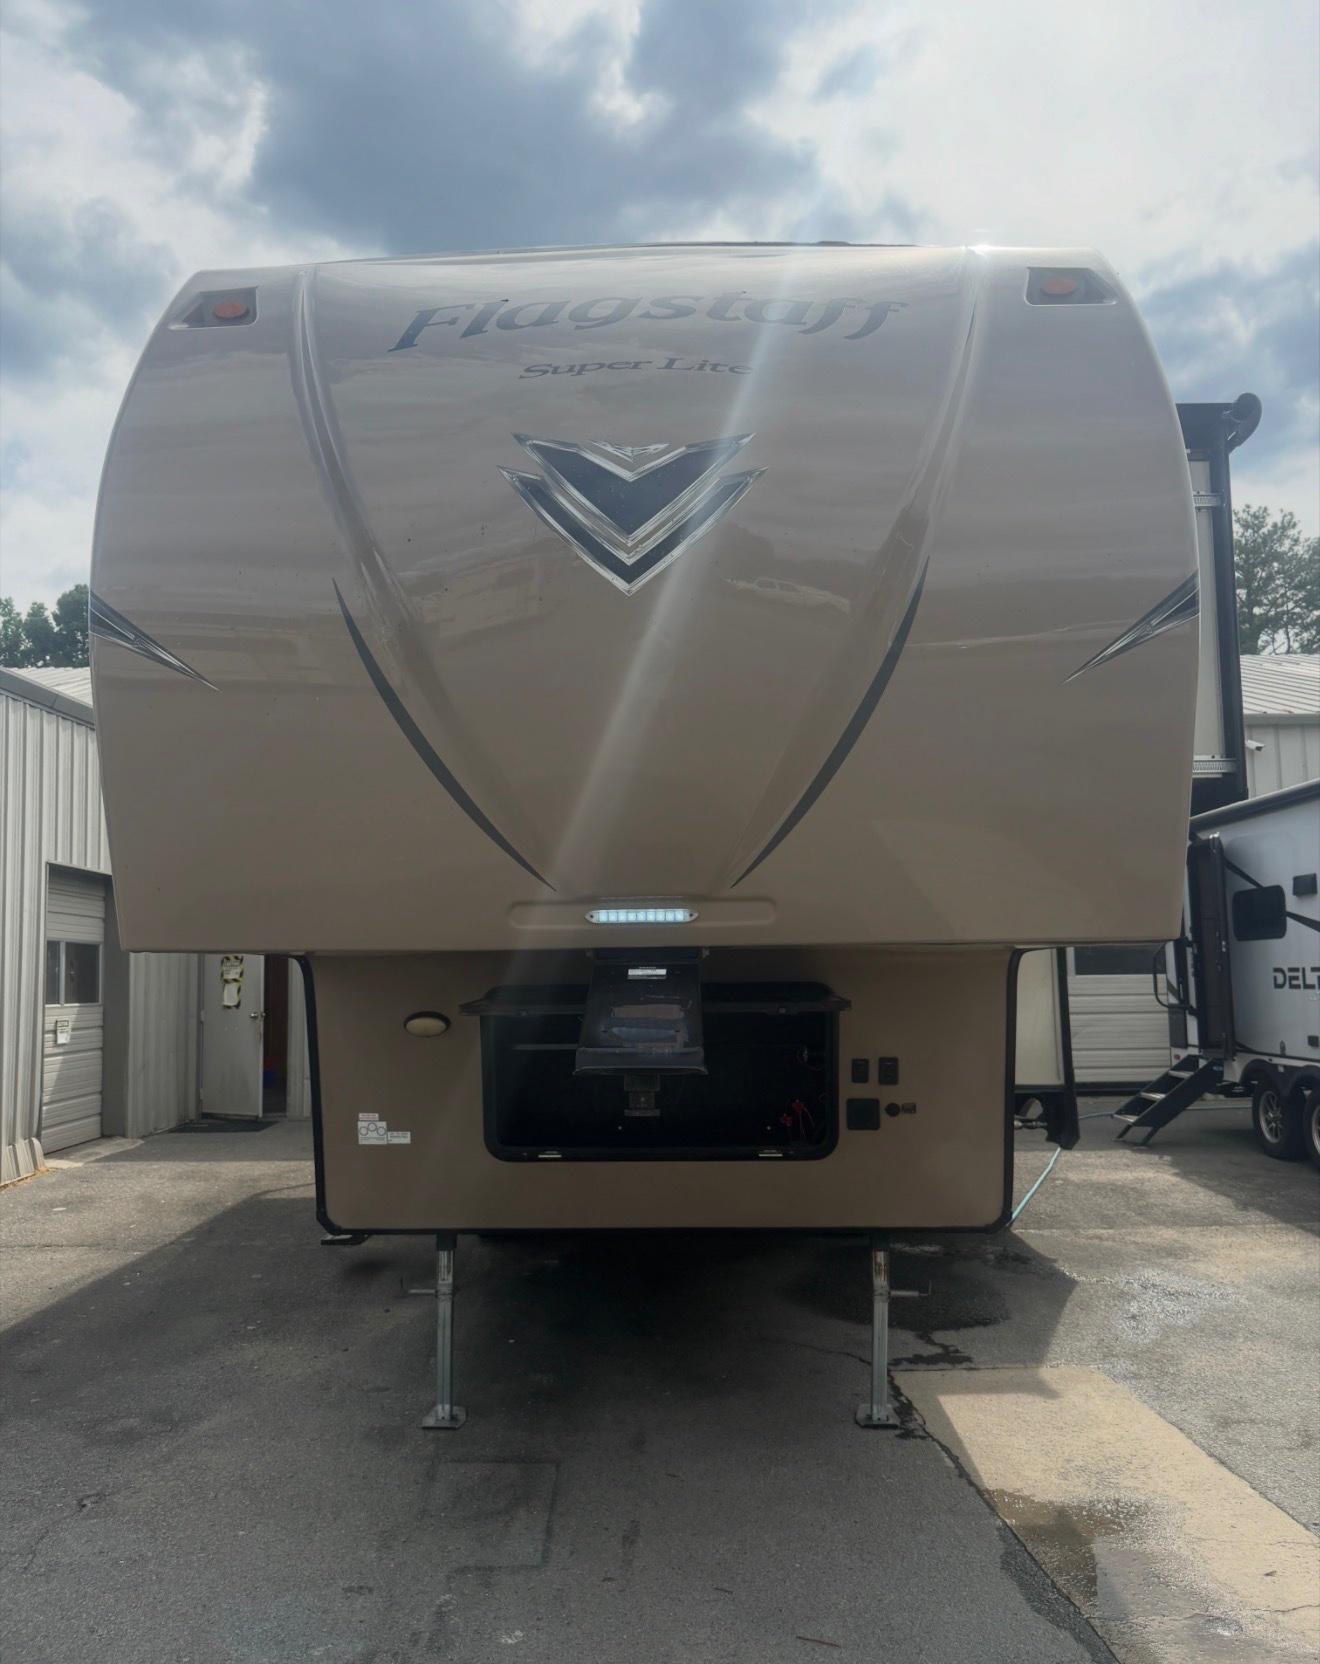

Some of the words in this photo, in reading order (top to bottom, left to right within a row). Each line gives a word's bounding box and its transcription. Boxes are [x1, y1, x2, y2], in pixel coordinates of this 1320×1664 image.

[387, 291, 909, 352] Flagstaff
[518, 359, 652, 379] Super
[657, 356, 754, 375] Lite
